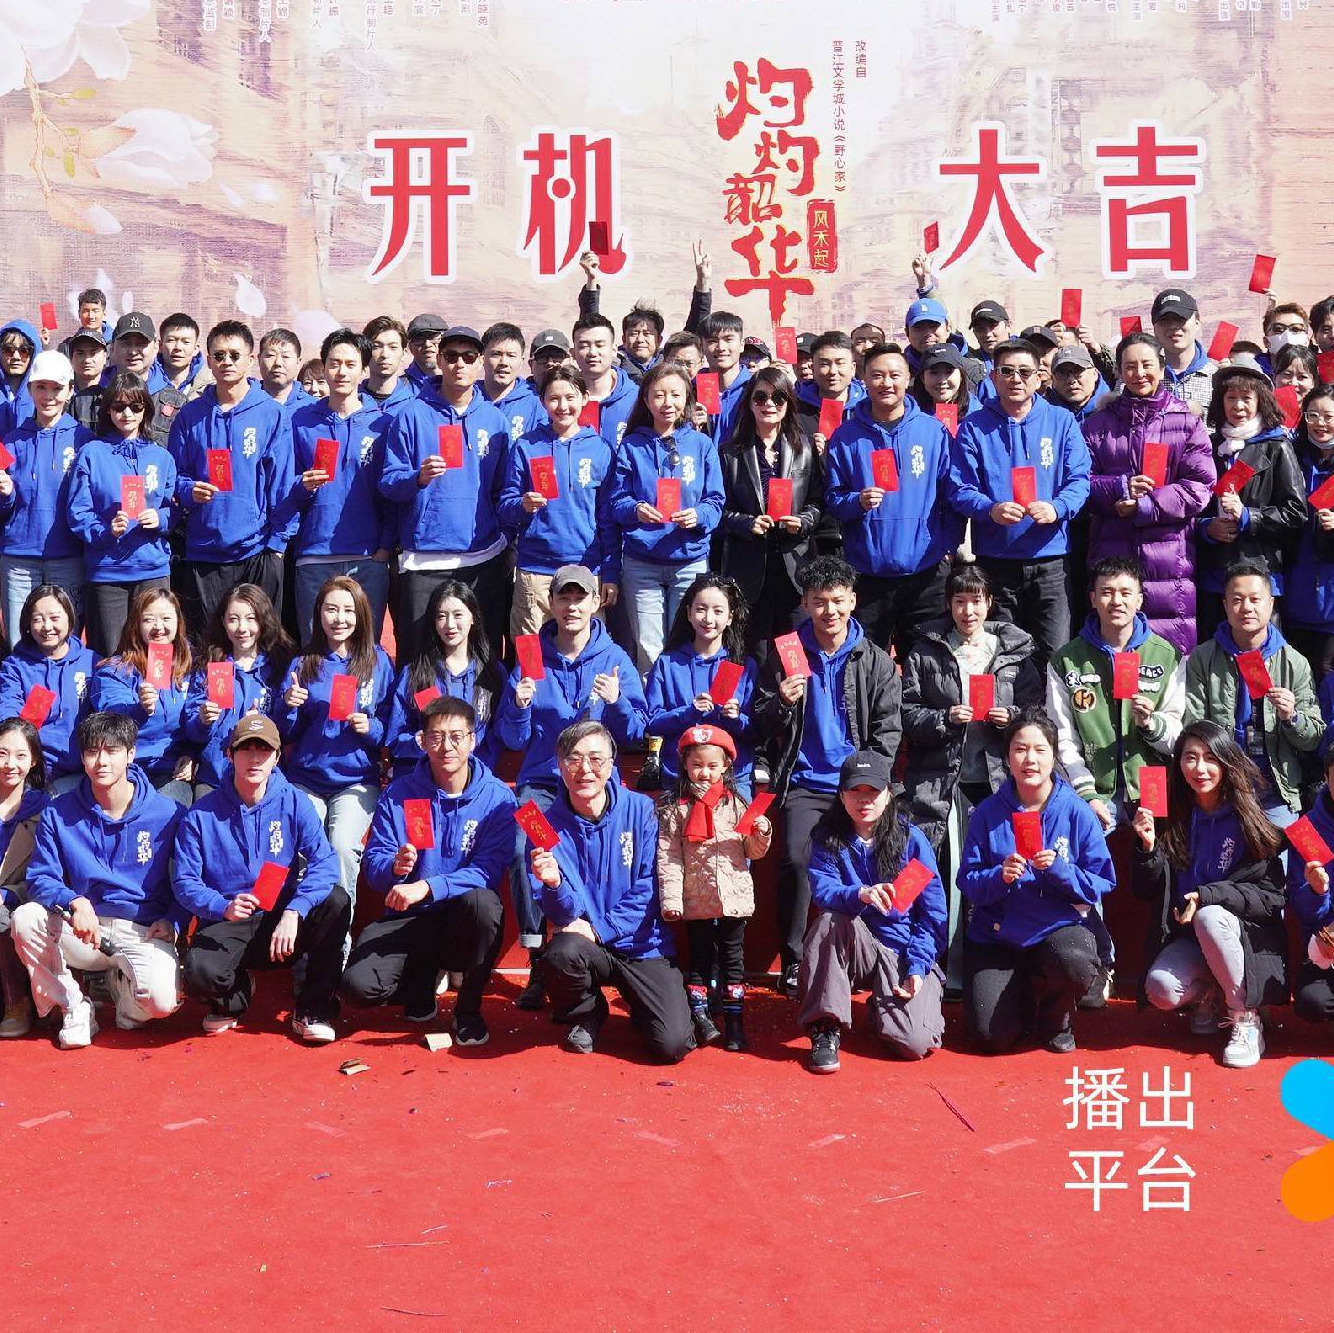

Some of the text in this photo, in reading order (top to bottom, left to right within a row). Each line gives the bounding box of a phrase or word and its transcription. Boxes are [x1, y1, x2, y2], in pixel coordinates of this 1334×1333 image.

[831, 40, 847, 193] 晋江文学城小说《野心家》
[854, 39, 868, 79] 改编自
[371, 127, 1200, 276] 开机 大吉
[717, 58, 820, 329] 灼灼韶华
[812, 210, 830, 268] 风禾起
